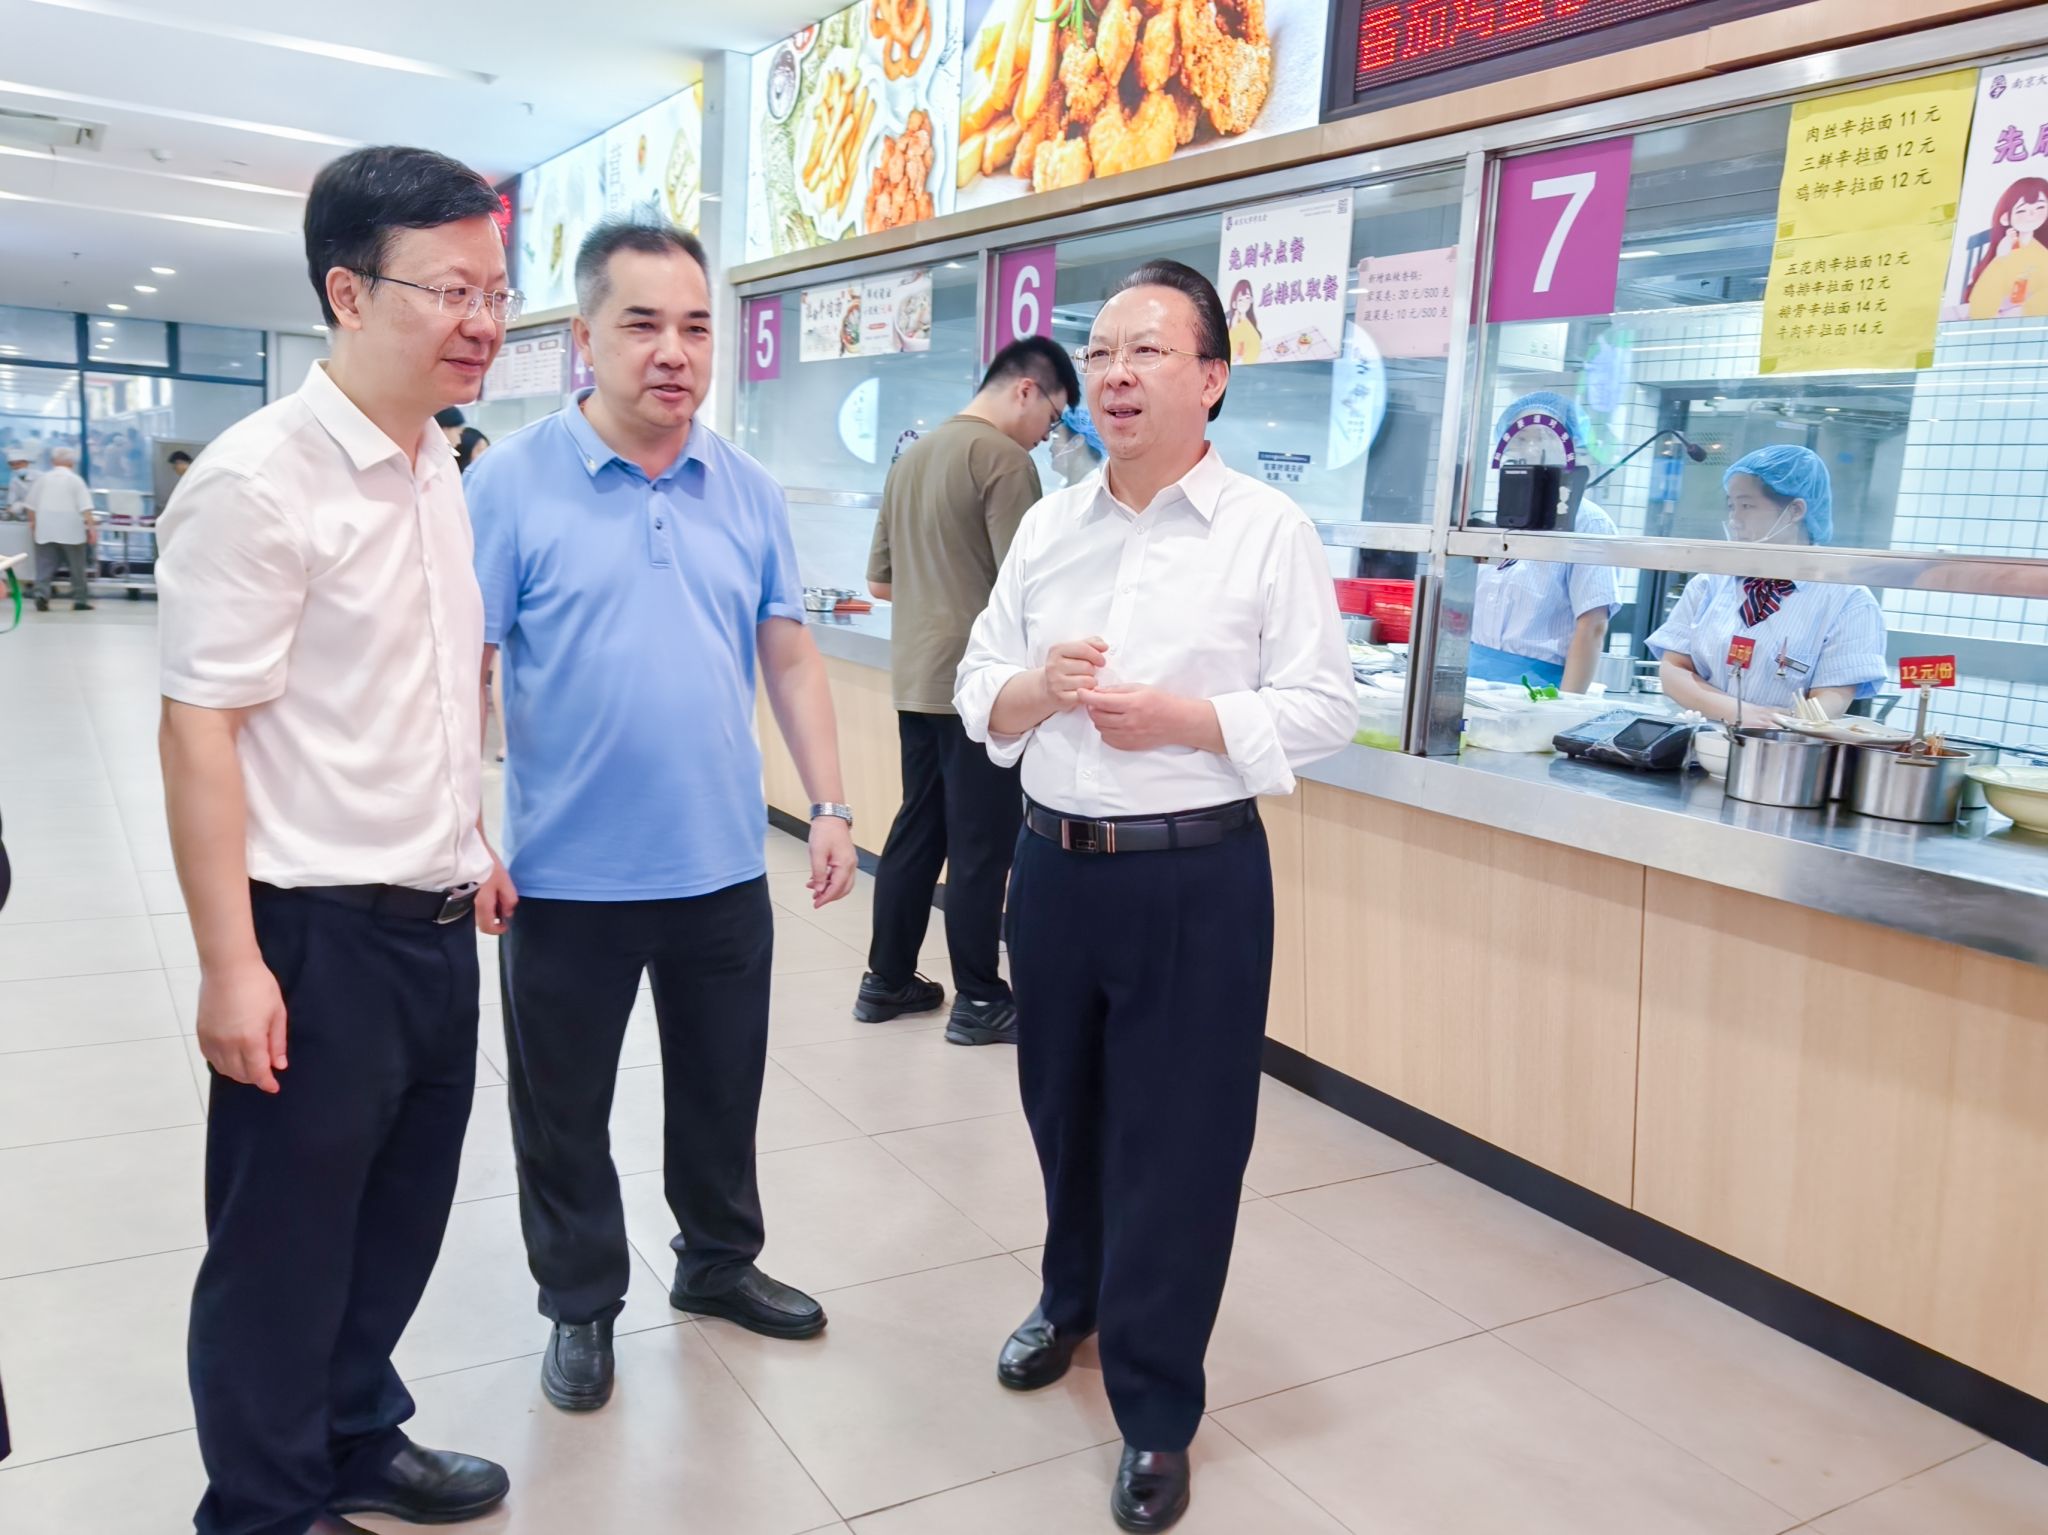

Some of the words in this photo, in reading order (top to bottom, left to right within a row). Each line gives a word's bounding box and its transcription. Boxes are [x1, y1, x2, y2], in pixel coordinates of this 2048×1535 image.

[1806, 113, 1893, 143] 肉丝辛拉面
[1900, 110, 1916, 127] 11
[1923, 105, 1942, 122] 元
[1799, 145, 1889, 172] 三鲜辛拉面
[1896, 141, 1914, 158] 12
[1918, 137, 1936, 154] 元
[1891, 172, 1909, 189] 12
[1914, 168, 1932, 185] 元
[1531, 171, 1596, 293] 7
[1228, 236, 1305, 271] 先刷卡点餐
[1878, 253, 1892, 267] 12
[1895, 251, 1911, 265] 元
[1258, 274, 1339, 308] 后排队取餐
[1860, 277, 1874, 291] 12
[1877, 275, 1891, 290] 元
[1011, 265, 1041, 340] 6
[1856, 300, 1870, 313] 14
[1874, 298, 1888, 312] 元
[756, 310, 774, 368] 5
[1852, 322, 1866, 335] 14
[1870, 320, 1884, 335] 元
[1901, 666, 1916, 680] 12
[1920, 662, 1953, 681] 元/份
